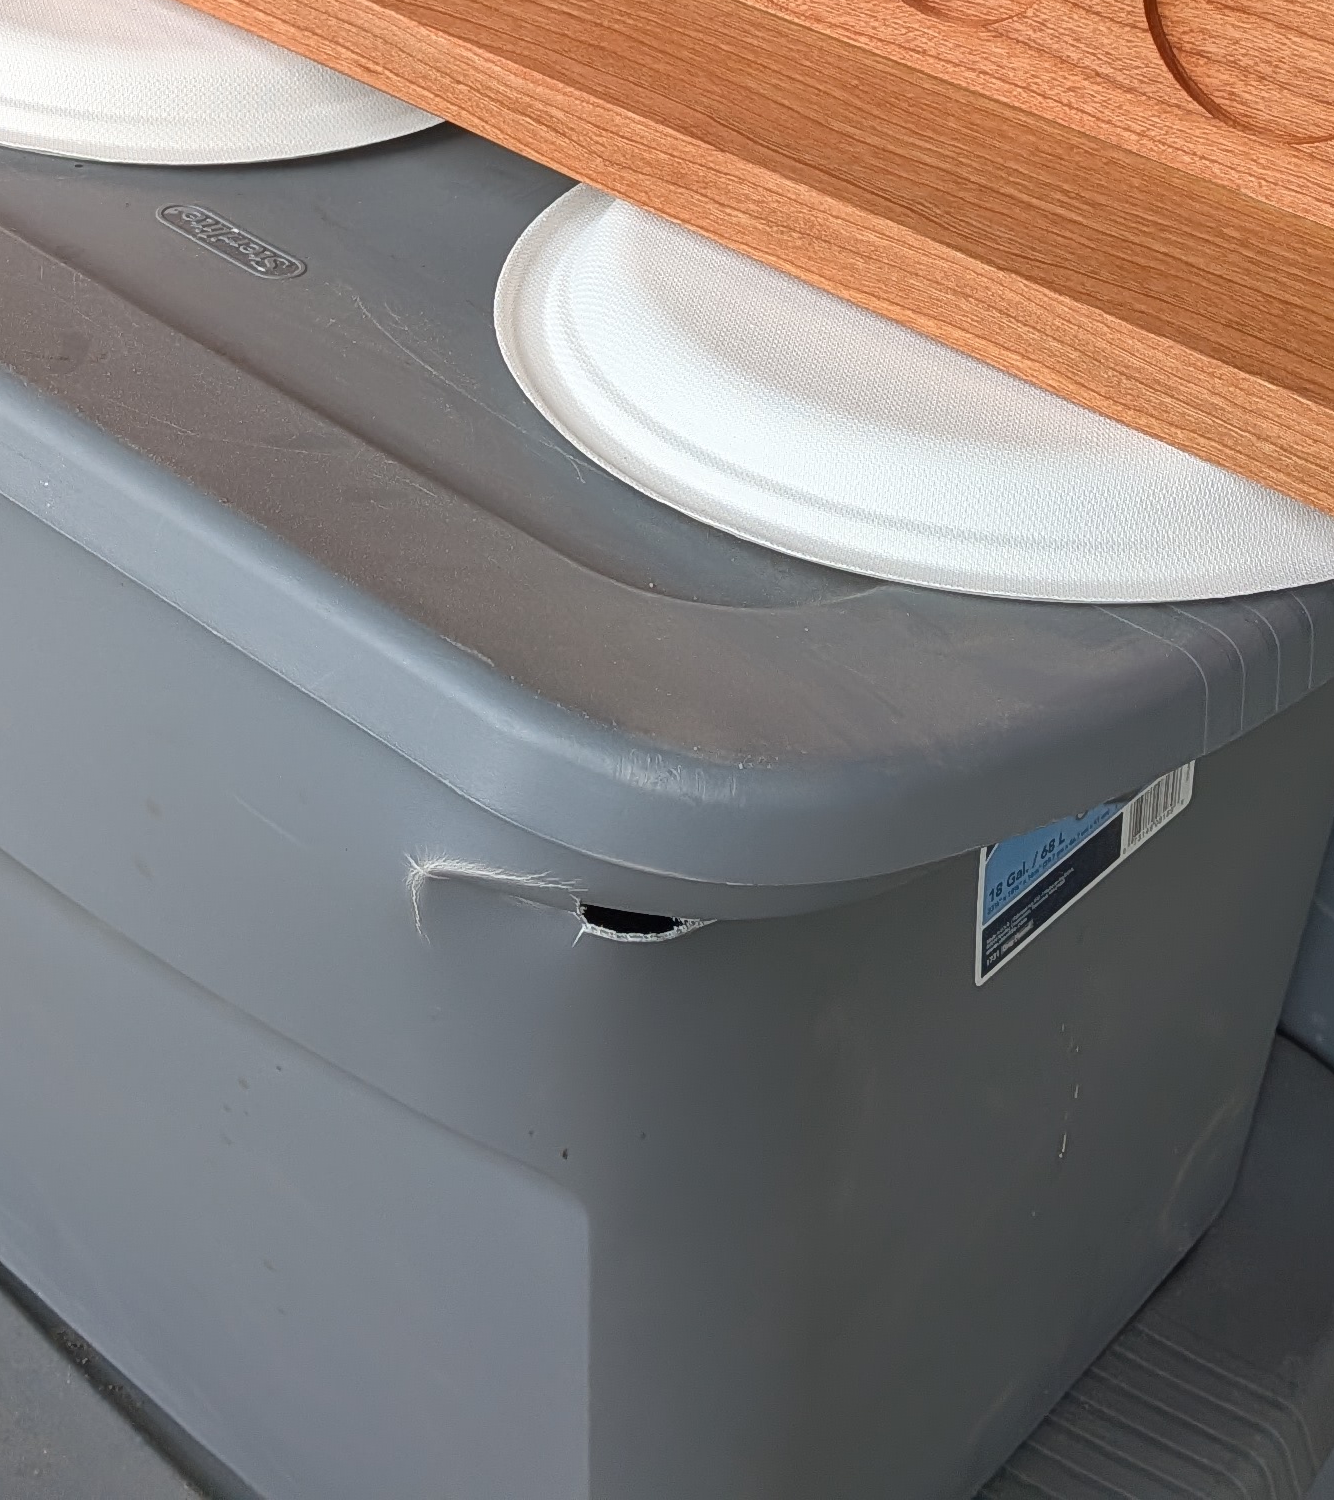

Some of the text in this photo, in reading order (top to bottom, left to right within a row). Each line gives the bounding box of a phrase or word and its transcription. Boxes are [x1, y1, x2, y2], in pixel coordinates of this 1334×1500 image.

[988, 882, 1003, 902] 18
[1006, 861, 1029, 887] Gal.
[1040, 838, 1055, 860] 68
[1058, 832, 1066, 846] L
